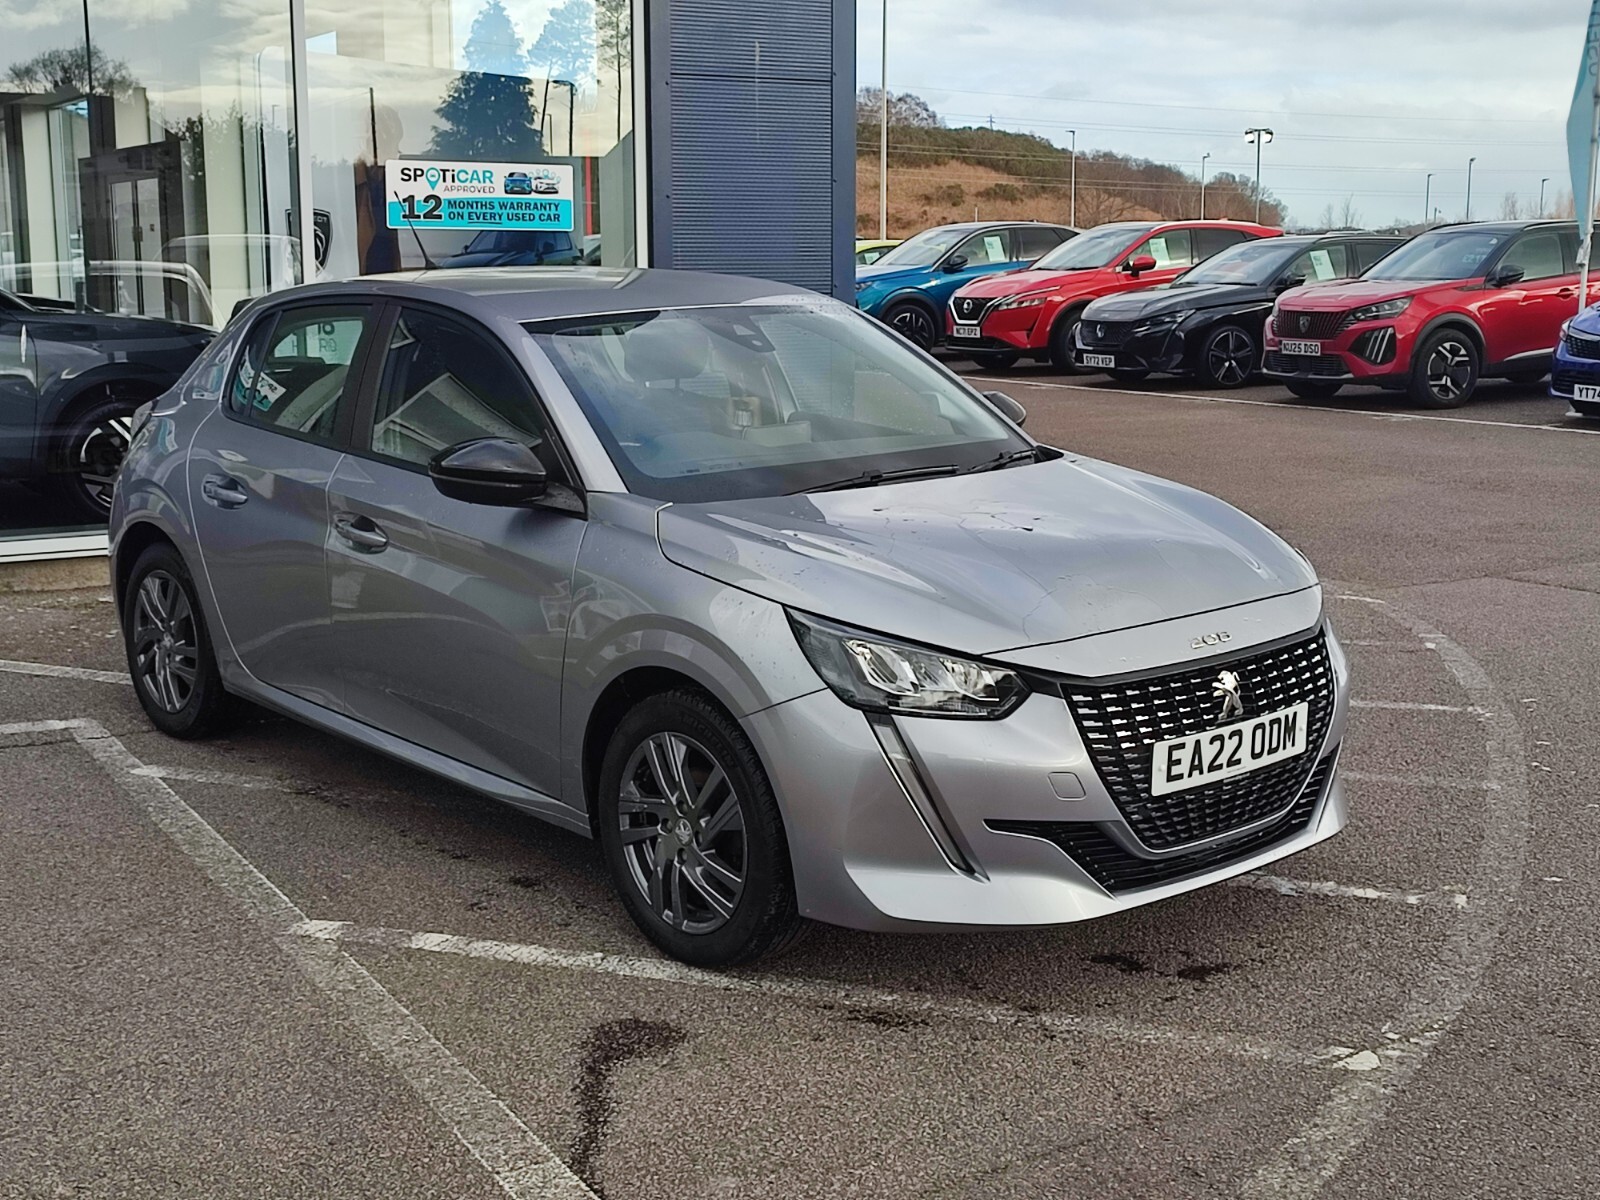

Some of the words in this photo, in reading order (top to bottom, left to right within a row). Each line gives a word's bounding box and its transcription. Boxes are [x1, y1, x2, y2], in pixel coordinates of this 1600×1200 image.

[443, 185, 496, 194] APPROVED
[401, 194, 443, 220] 12
[447, 200, 496, 210] MONTHS
[499, 201, 561, 211] WARRANTY
[448, 211, 465, 221] ON
[468, 212, 503, 223] EVERY
[506, 212, 536, 222] USED
[539, 213, 561, 223] CAR
[1166, 728, 1243, 783] EA22
[1250, 710, 1298, 761] ODM
